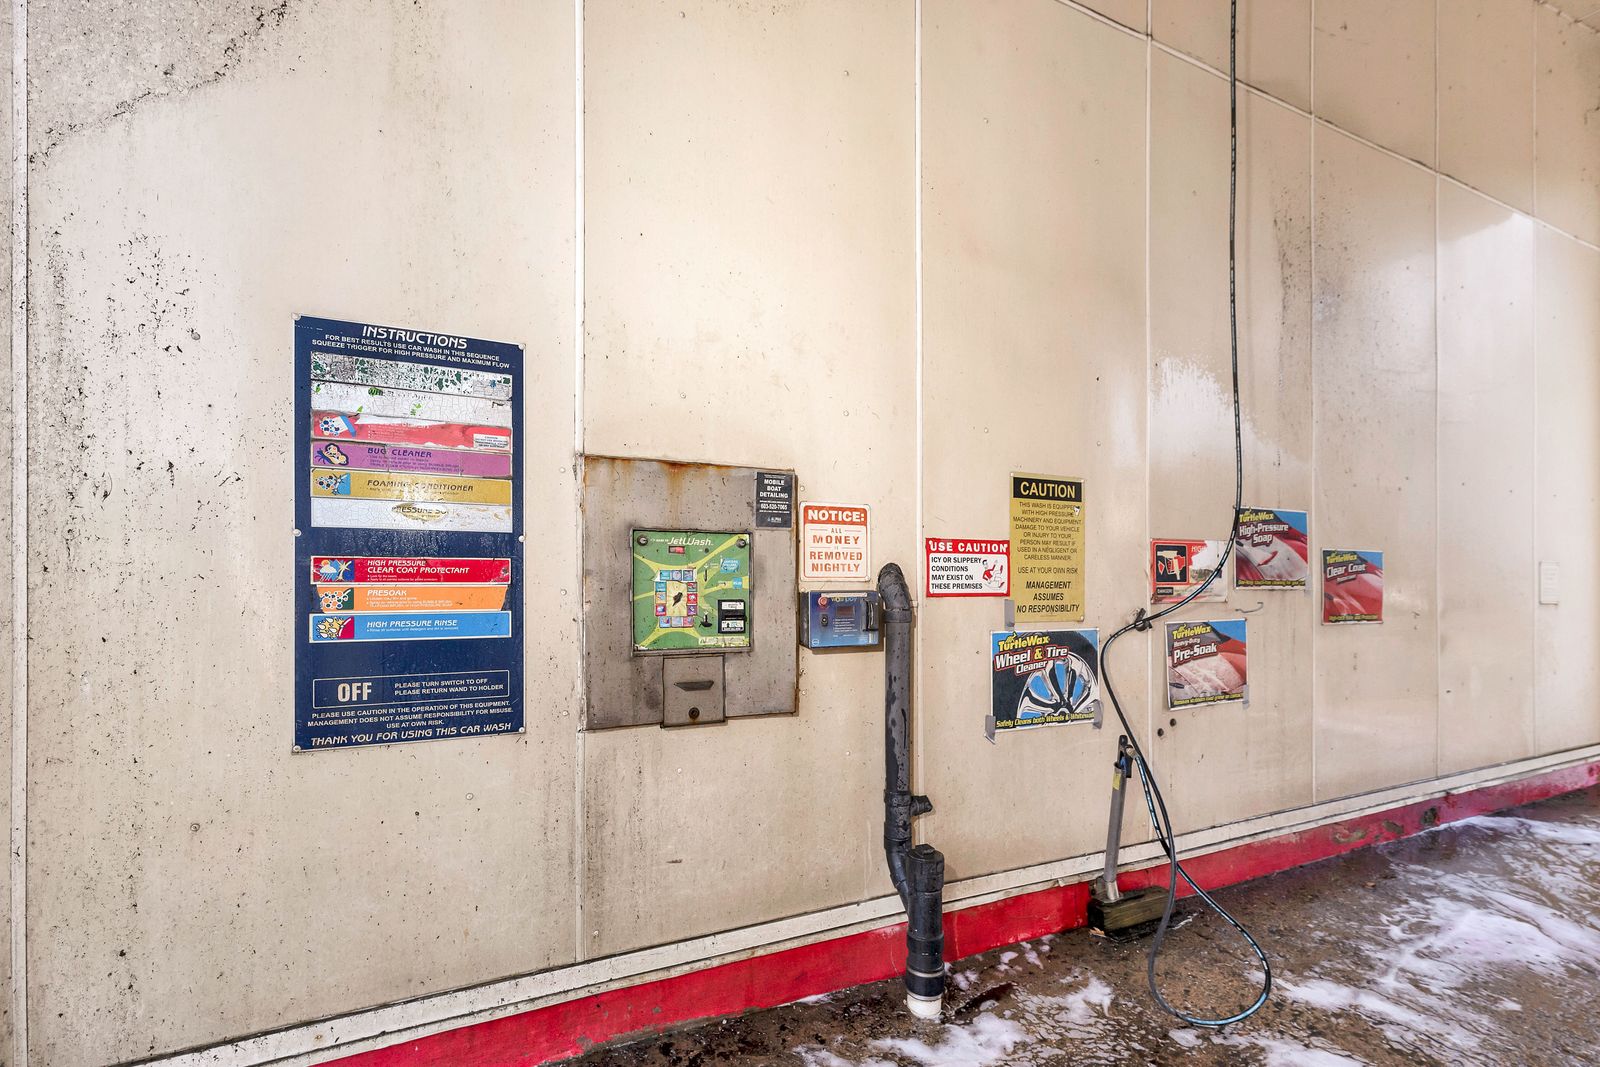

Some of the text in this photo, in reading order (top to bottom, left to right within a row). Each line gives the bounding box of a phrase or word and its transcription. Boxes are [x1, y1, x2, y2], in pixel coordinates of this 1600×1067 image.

[362, 325, 467, 349] INSTRUCTIONS
[312, 339, 345, 349] SQUEEZE
[346, 343, 377, 352] TRIGGER
[412, 351, 446, 360] PRESSURE
[462, 358, 491, 366] MAXIMUM
[361, 338, 392, 348] RESULTS
[466, 351, 500, 361] SEQUENCE
[392, 449, 432, 458] CLEANER
[415, 482, 473, 492] CONDITIONER
[1020, 481, 1076, 498] CAUTION
[808, 510, 864, 522] NOTICE:
[1239, 523, 1288, 537] High-Pressure
[667, 537, 711, 546] JetWash
[813, 535, 859, 545] MONEY
[1253, 534, 1272, 544] Soap
[930, 542, 1008, 552] USE CAUTION
[810, 551, 863, 560] REMOVED
[812, 563, 860, 572] NIGHTLY
[1327, 566, 1347, 579] Clear
[1348, 564, 1366, 572] Coat
[1026, 581, 1071, 589] MANAGEMENT
[1016, 604, 1080, 613] NO RESPONSIBILITY
[1172, 626, 1211, 640] TurtleWax
[998, 635, 1050, 652] TurtleWax
[995, 646, 1068, 669] Wheel & Tire
[1174, 643, 1217, 663] Pre-Soak
[1016, 660, 1047, 674] Cleaner
[337, 682, 372, 702] OFF
[308, 718, 358, 727] MANAGEMENT
[424, 710, 474, 719] RESPONSIBILITY
[996, 720, 1014, 728] Safely
[1014, 718, 1031, 726] Cleans
[311, 722, 512, 746] THANK YOU FOR USING THIS CAR WASH
